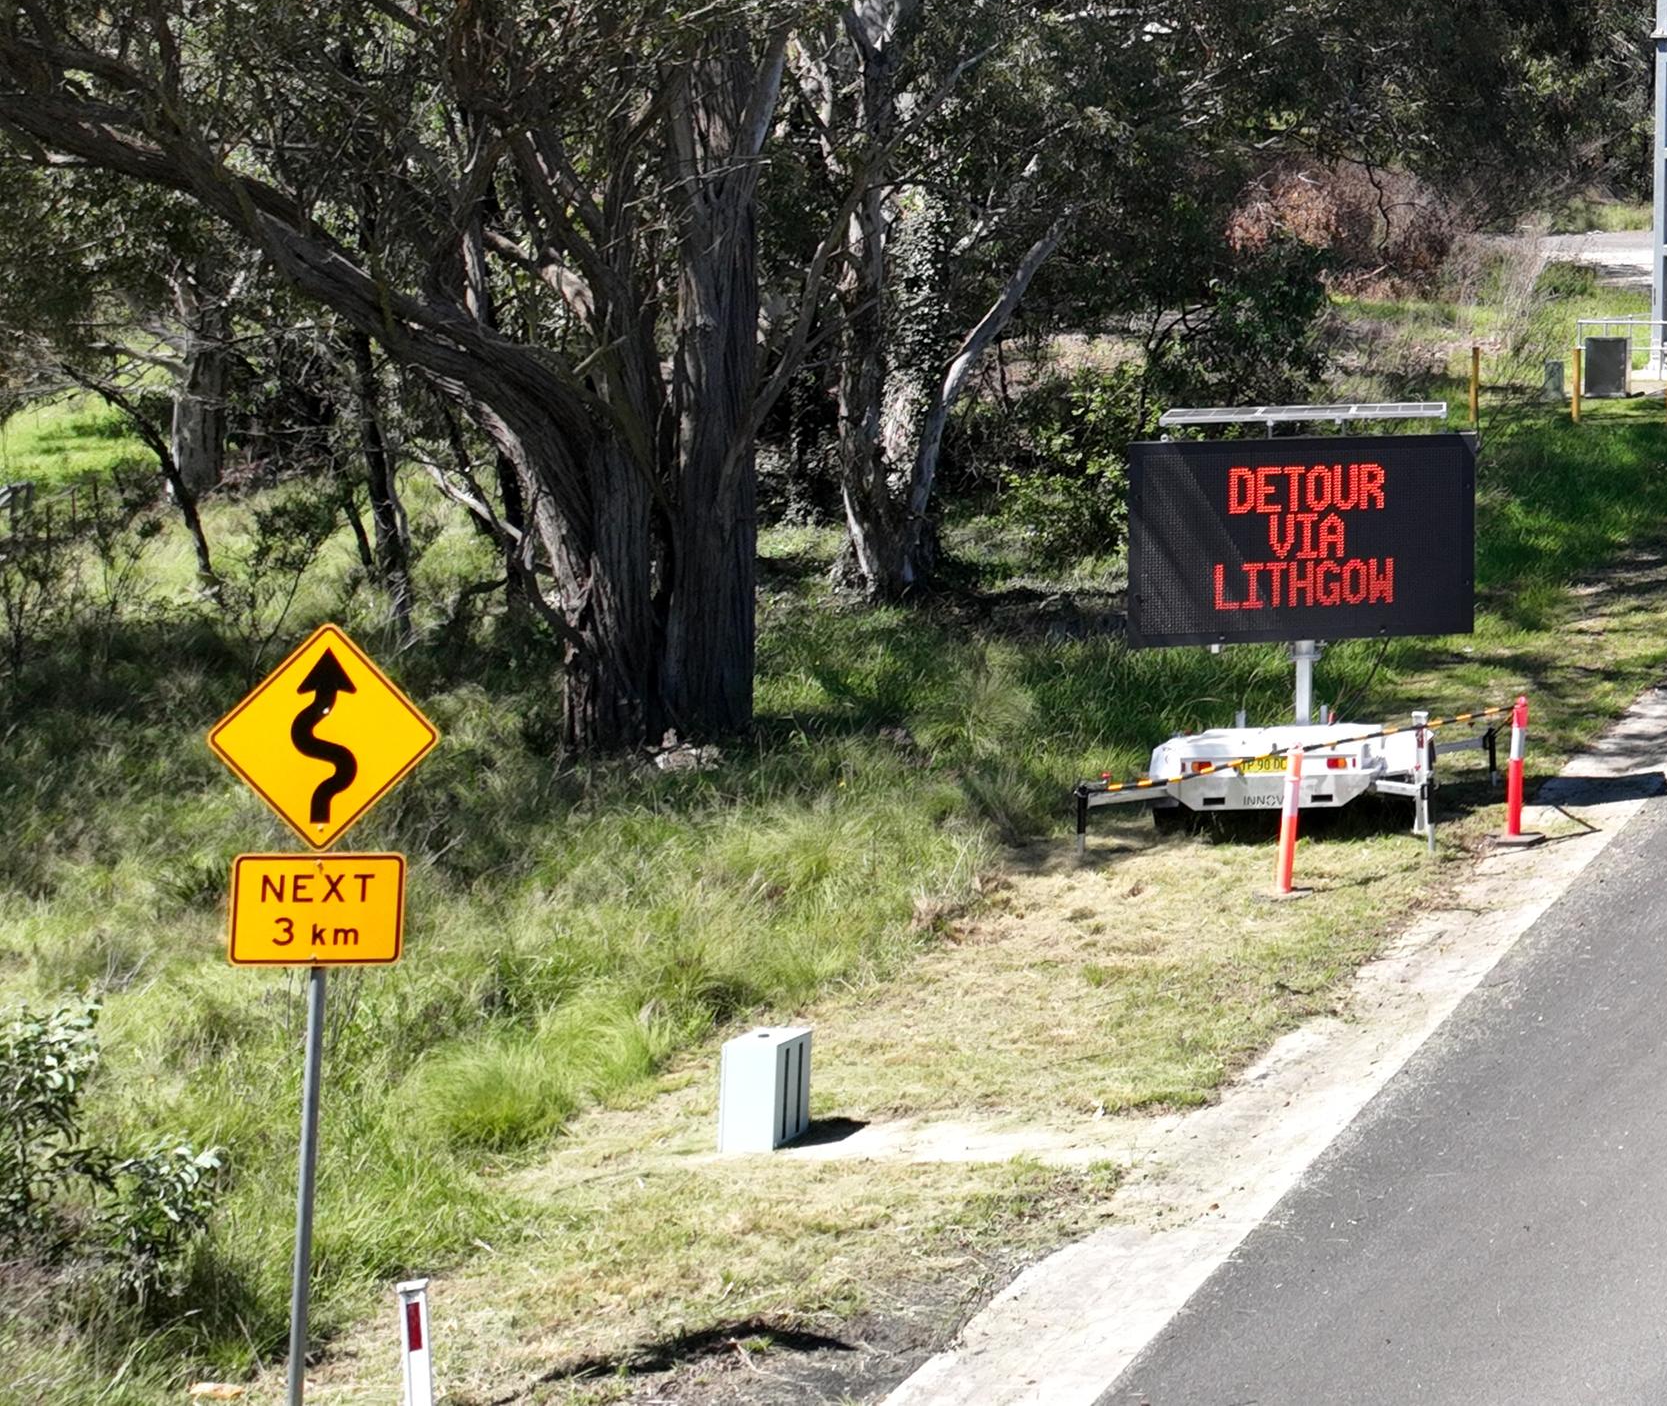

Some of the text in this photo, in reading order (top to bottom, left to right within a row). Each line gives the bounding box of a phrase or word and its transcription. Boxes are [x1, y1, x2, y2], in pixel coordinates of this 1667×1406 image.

[1228, 463, 1385, 514] DETOUR
[1268, 512, 1345, 559] VIA
[1213, 557, 1394, 611] LITHGOW
[261, 874, 375, 903] NEXT
[272, 917, 359, 946] 3 km
